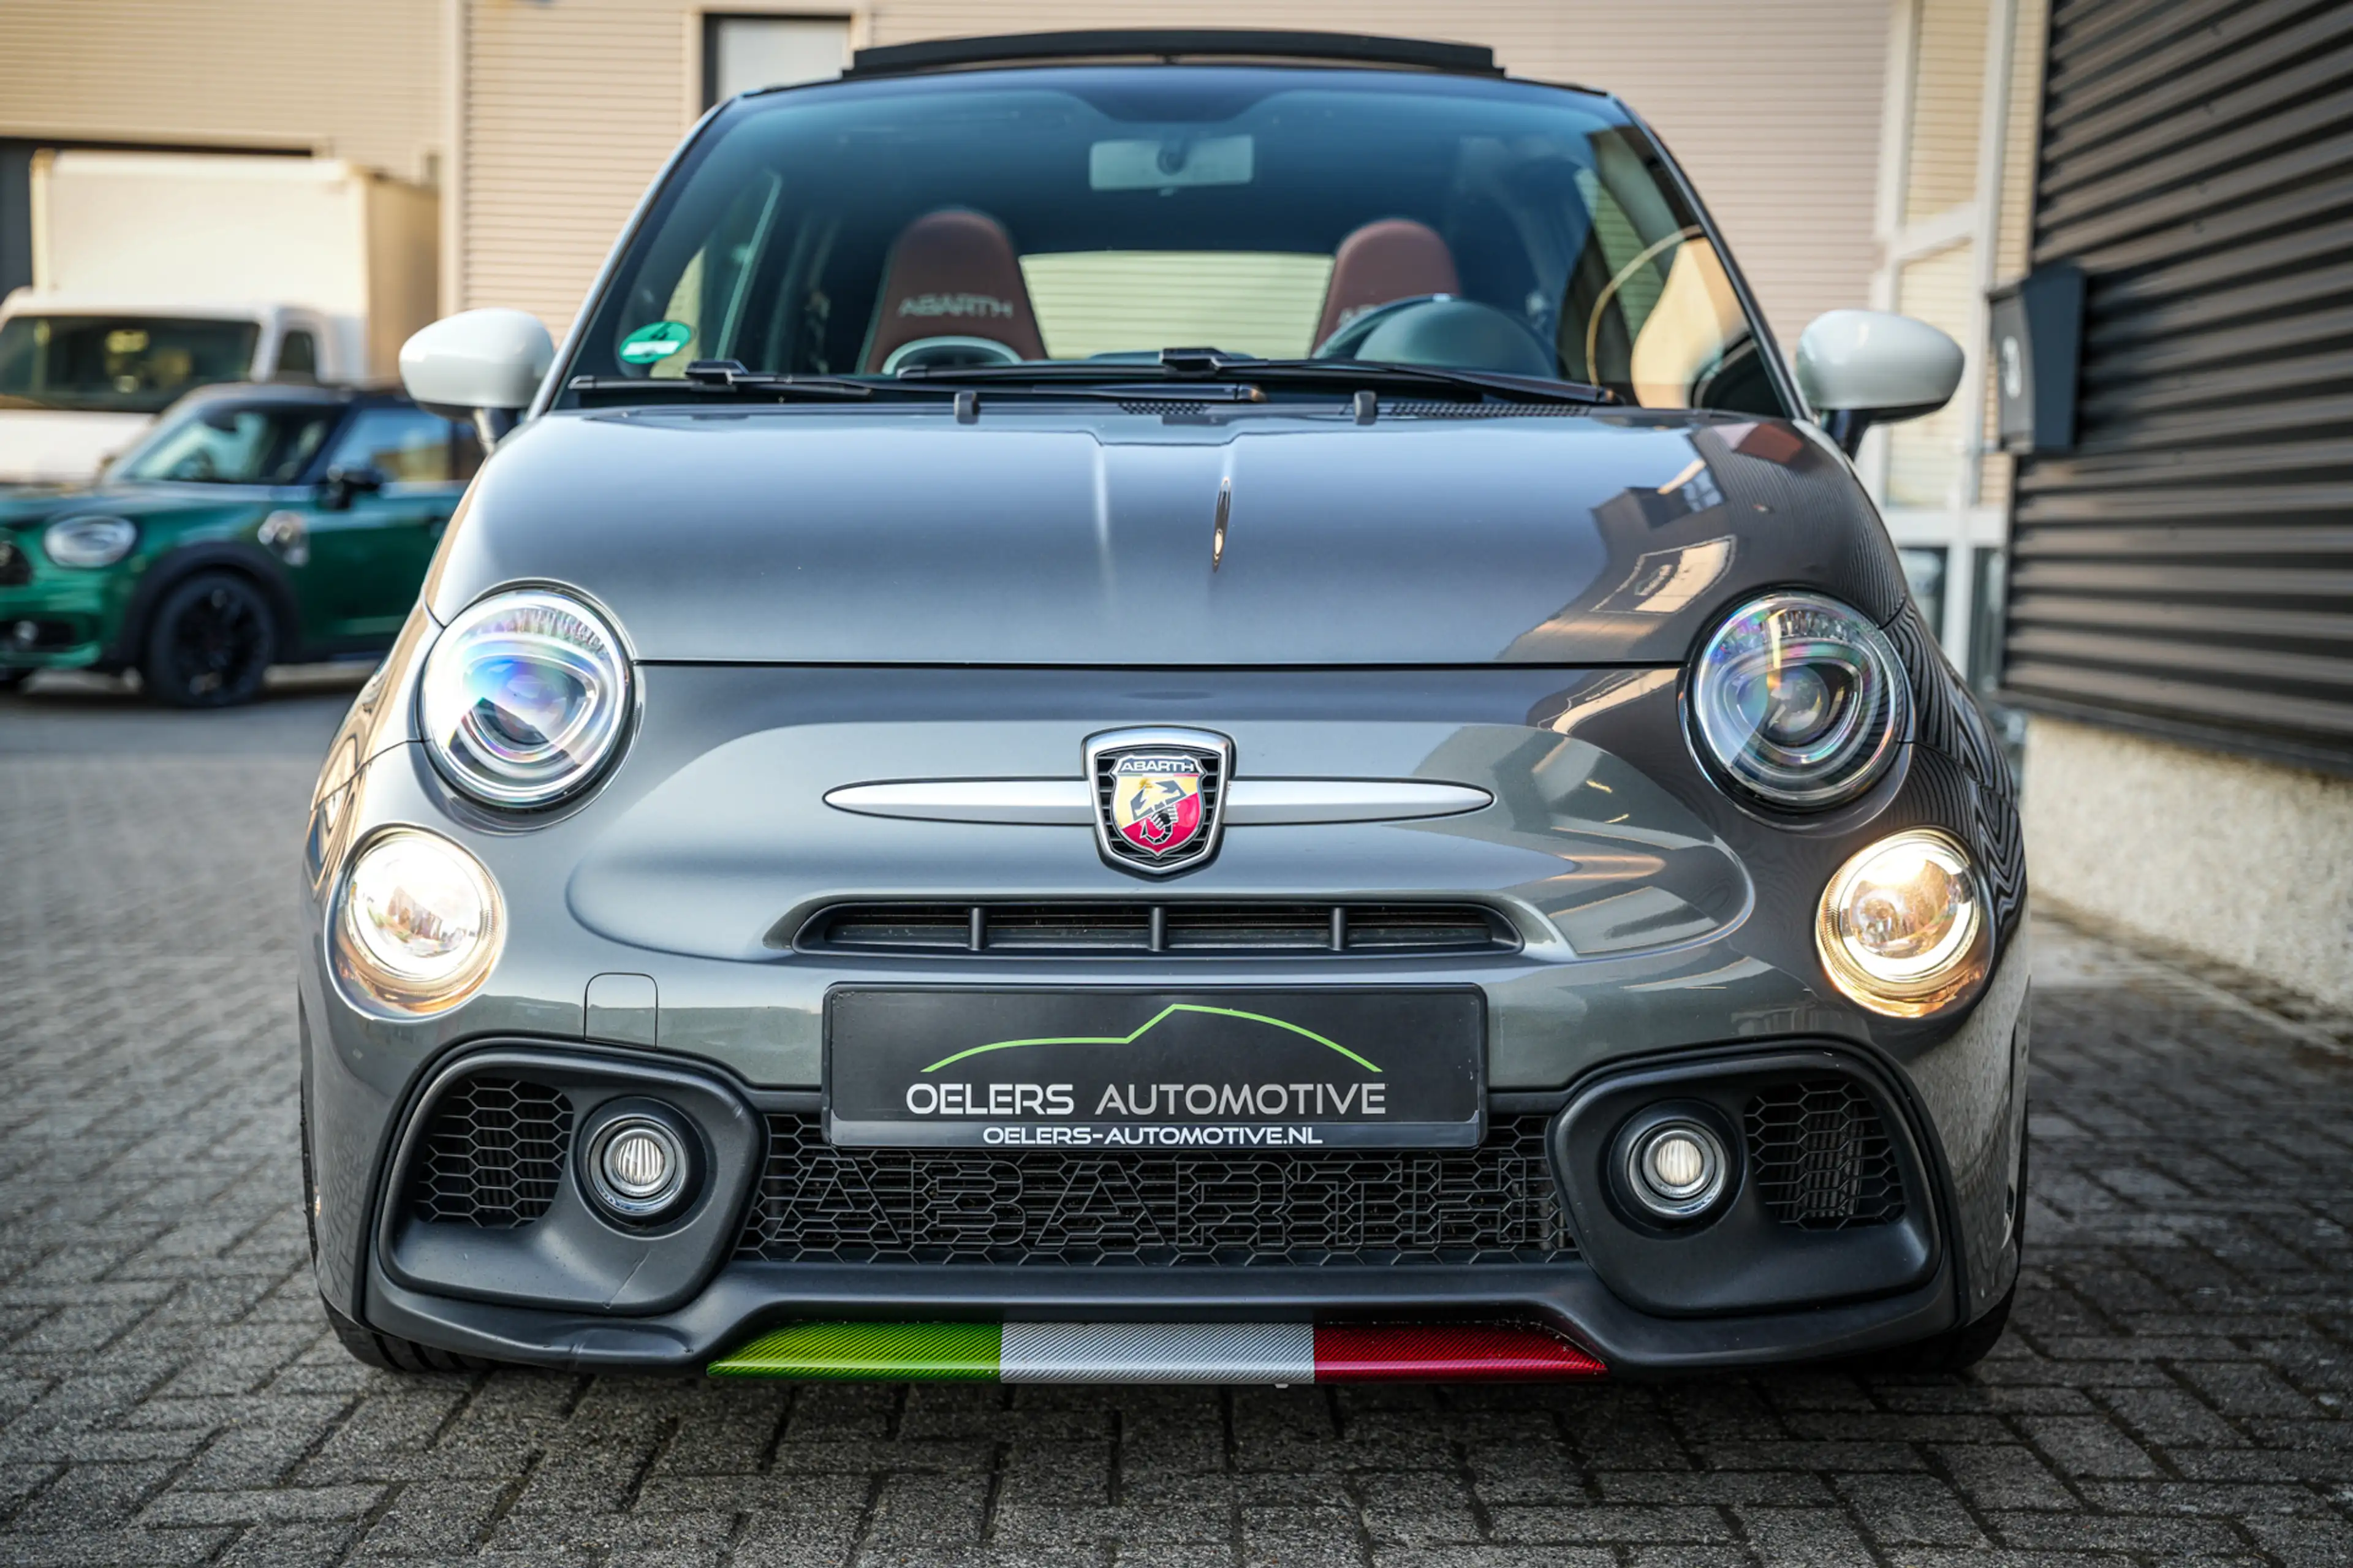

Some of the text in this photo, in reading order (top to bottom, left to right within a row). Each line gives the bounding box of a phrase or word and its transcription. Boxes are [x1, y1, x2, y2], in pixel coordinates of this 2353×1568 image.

[898, 294, 1014, 318] ABARTH
[1121, 760, 1194, 772] ABARTH
[906, 1083, 1385, 1115] OELERS AUTOMOTIVE
[983, 1126, 1324, 1145] OELERS-AUTOMOTIVE.NL
[773, 1157, 1526, 1245] ABARTH
